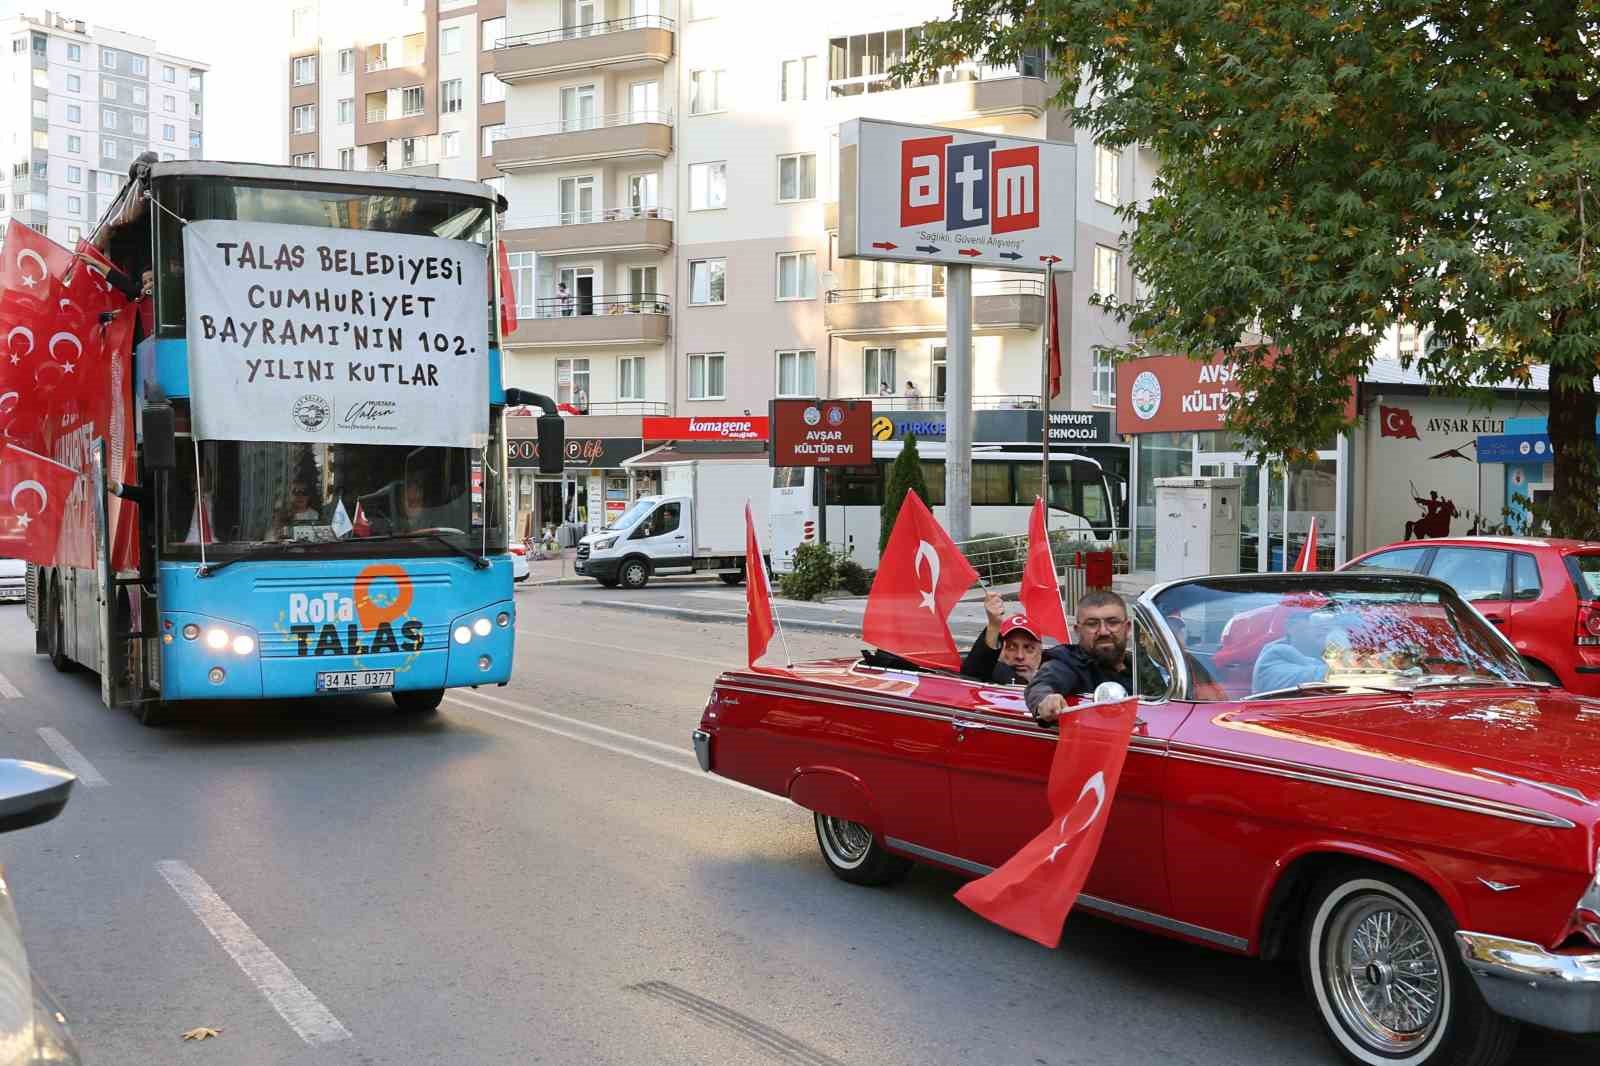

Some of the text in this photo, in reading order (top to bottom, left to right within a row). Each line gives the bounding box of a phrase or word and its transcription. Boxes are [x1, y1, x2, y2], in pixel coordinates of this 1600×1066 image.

[908, 155, 1034, 221] atm
[216, 241, 463, 285] TALAS BELEDİYESİ
[248, 284, 436, 321] CUMHURİYET
[418, 332, 476, 356] 102.
[246, 359, 439, 386] YILINI KUTLAR
[1198, 362, 1249, 384] AVŞA
[689, 418, 751, 436] komagene
[806, 431, 842, 441] AVŞAR
[1041, 427, 1097, 438] EKNOLOJİ
[1426, 416, 1504, 435] AVŞAR KÜLT
[794, 443, 834, 454] KÜLTÜR
[290, 620, 425, 656] TALAS
[326, 671, 391, 686] 34 AE 0377
